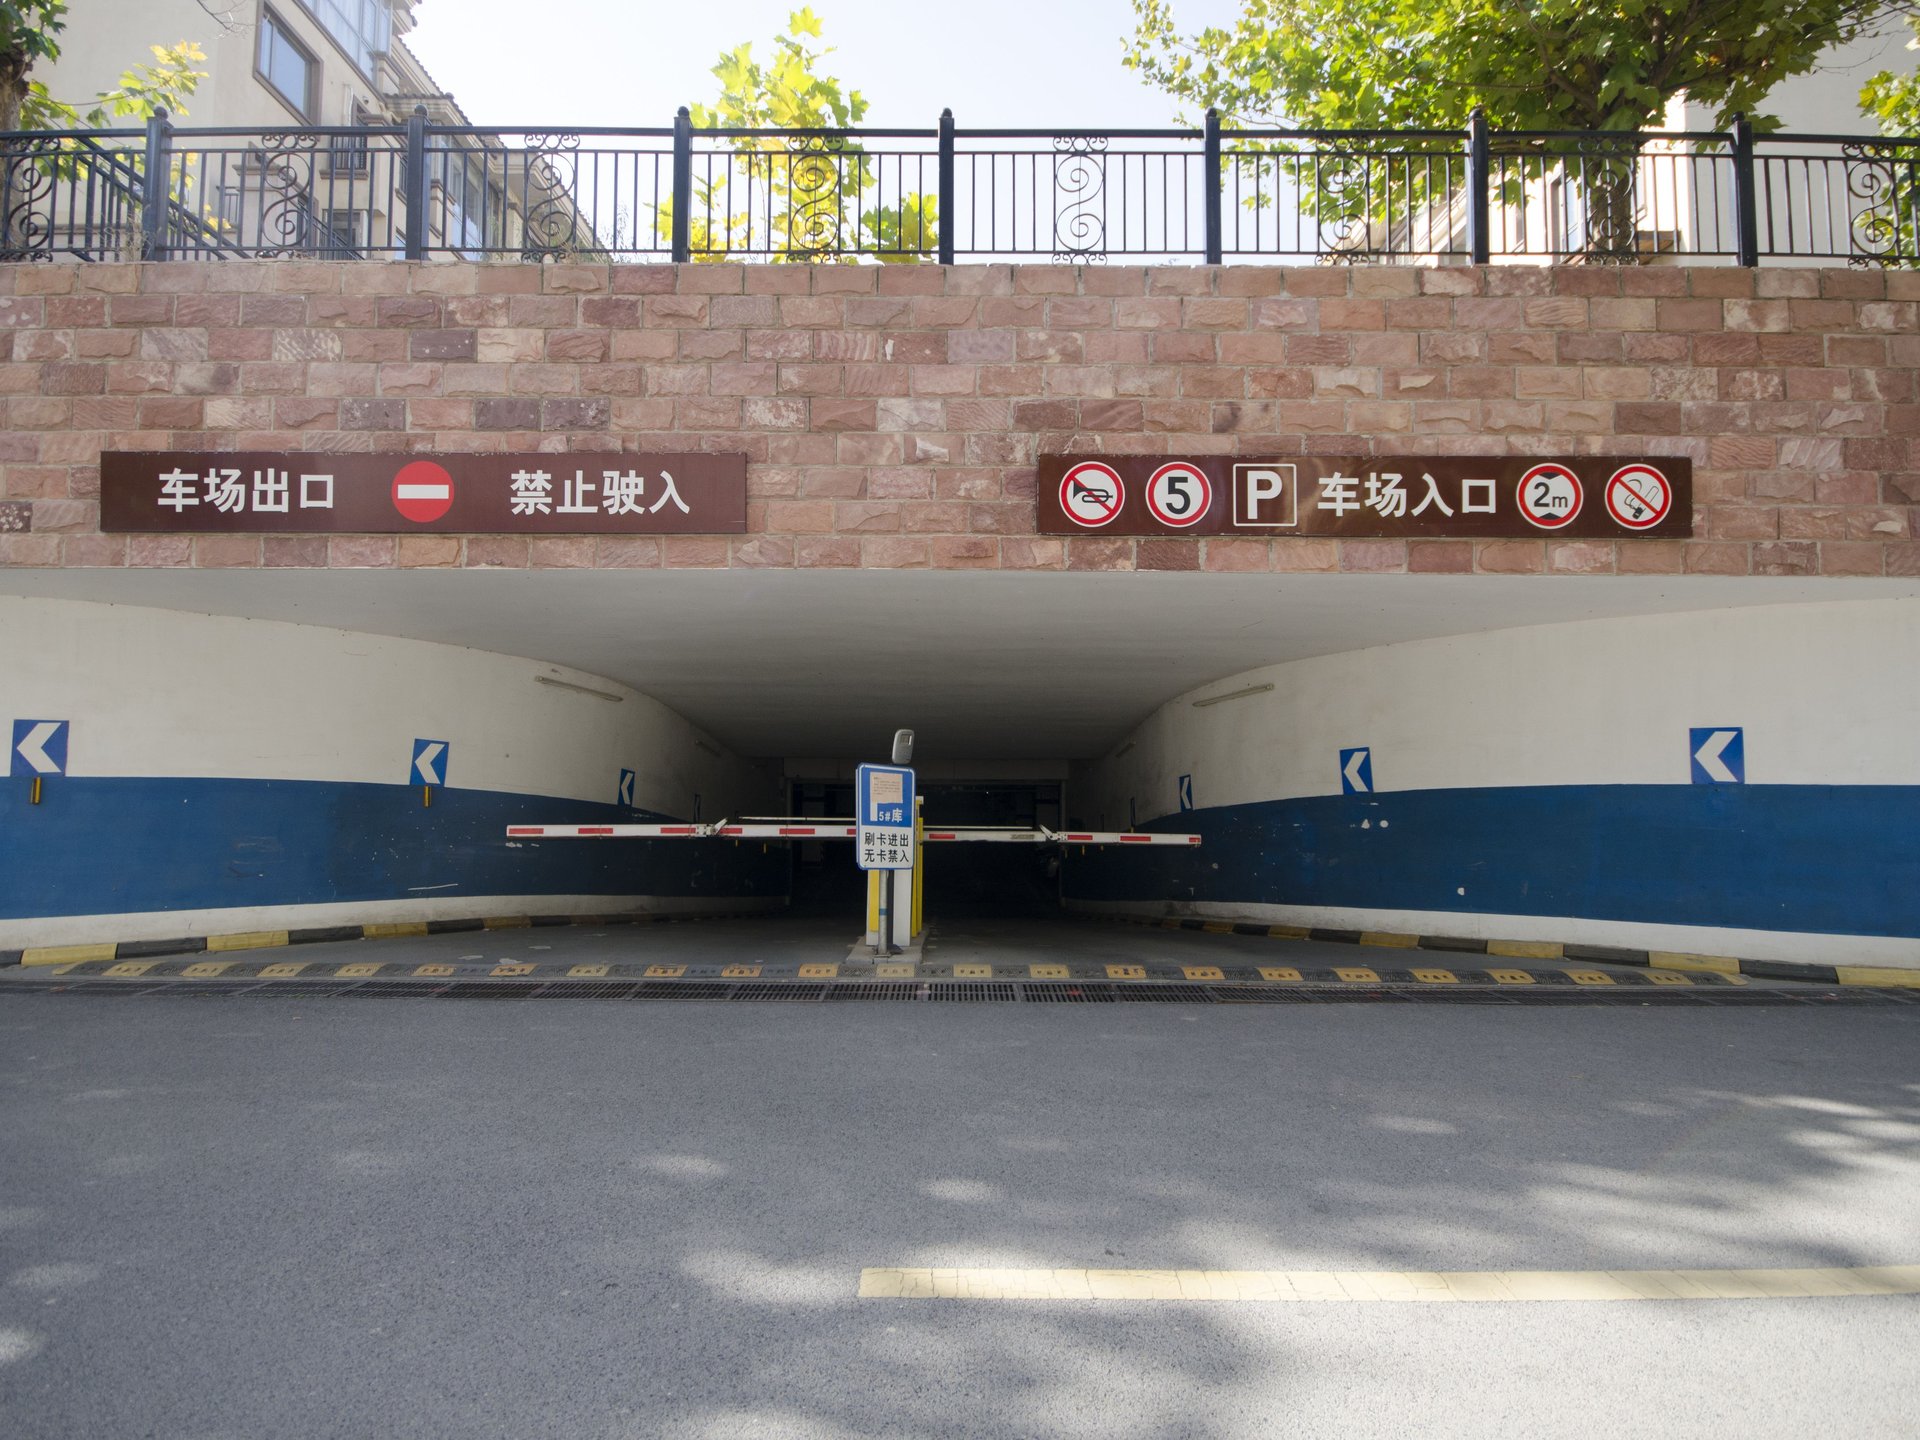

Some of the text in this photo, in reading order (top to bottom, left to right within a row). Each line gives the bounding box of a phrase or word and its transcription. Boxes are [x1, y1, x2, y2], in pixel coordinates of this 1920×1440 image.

[157, 467, 334, 513] 车场出口
[510, 469, 690, 516] 禁止驶入
[1166, 477, 1190, 514] 5
[1248, 471, 1282, 519] P
[1318, 472, 1497, 518] 车场入口
[1534, 482, 1568, 508] 2m
[879, 808, 902, 823] 5#库
[865, 832, 909, 847] 刷卡进出
[865, 849, 909, 863] 无卡禁入
